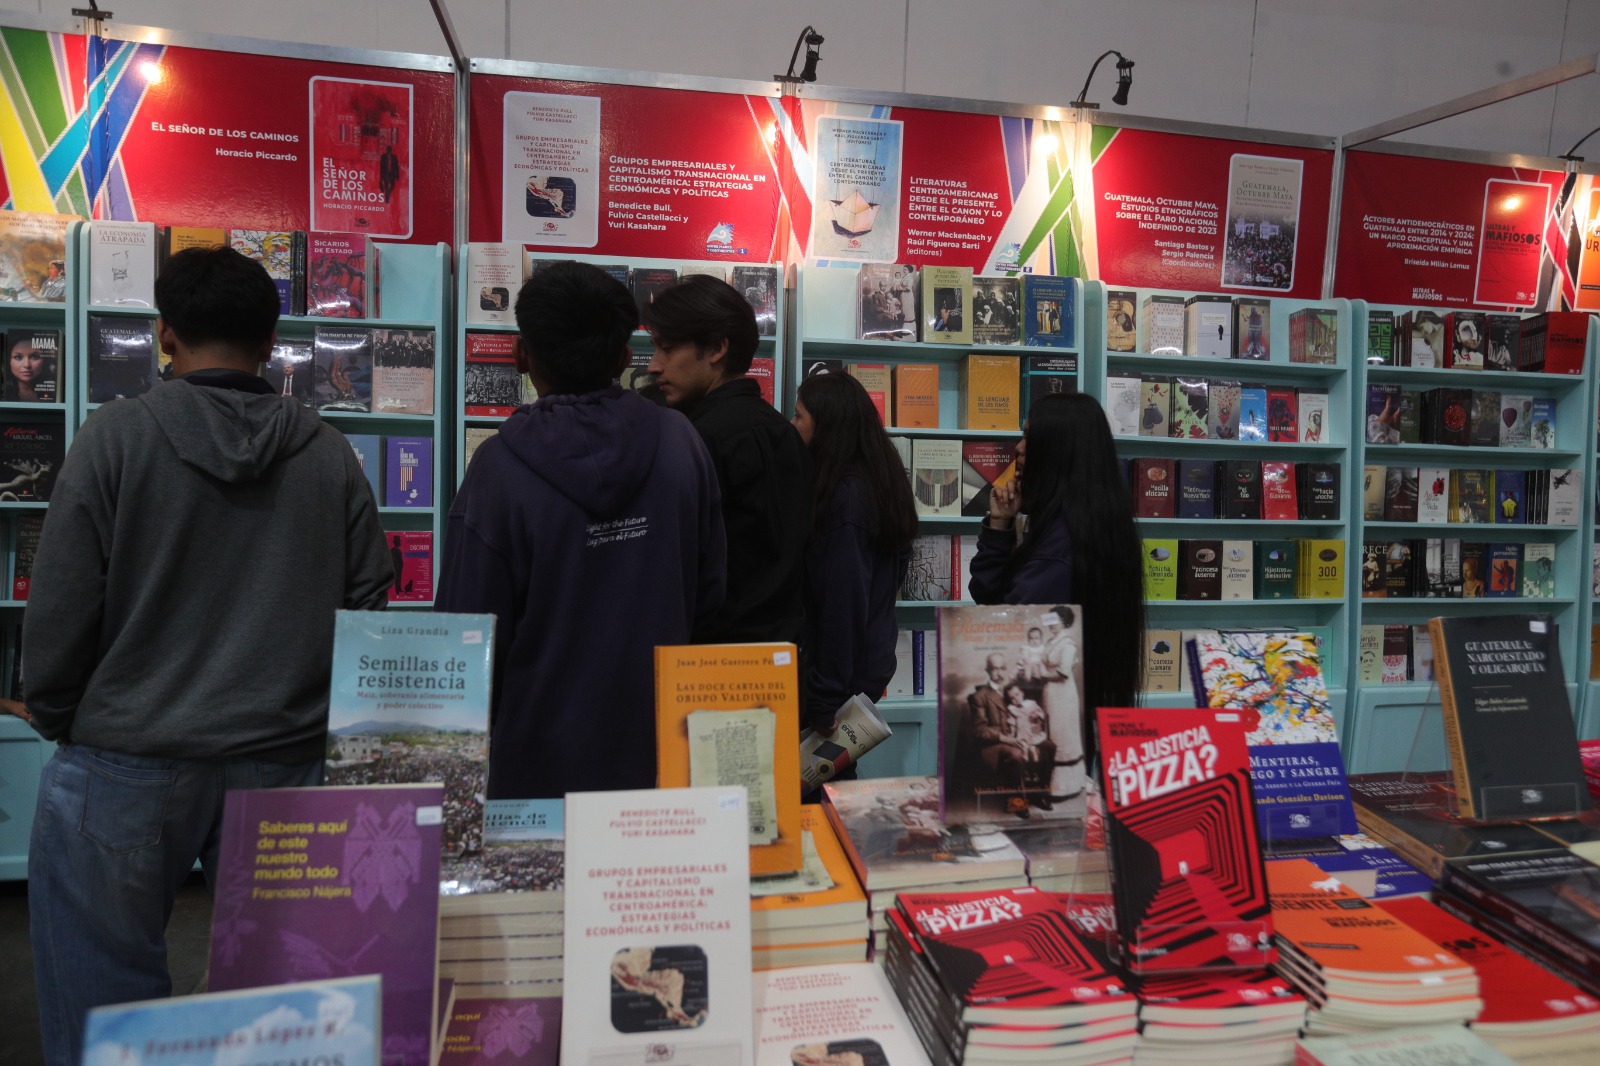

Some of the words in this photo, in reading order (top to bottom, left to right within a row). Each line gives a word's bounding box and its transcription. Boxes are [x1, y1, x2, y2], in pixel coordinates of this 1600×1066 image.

[152, 122, 165, 131] EL
[169, 124, 205, 135] SEÑOR
[209, 128, 223, 136] DE
[227, 130, 247, 138] LOS
[250, 132, 299, 142] CAMINOS
[216, 148, 253, 158] Horacio
[256, 151, 297, 161] Piccardo
[323, 158, 335, 168] EL
[610, 156, 648, 165] GRUPOS
[652, 160, 726, 170] EMPRESARIALES
[323, 167, 366, 180] SEÑOR
[609, 166, 670, 176] CAPITALISMO
[674, 170, 751, 181] TRANSNACIONAL
[324, 179, 338, 188] DE
[342, 181, 363, 190] LOS
[609, 176, 691, 186] CENTROAMÉRICA:
[694, 181, 753, 190] ESTRATEGIAS
[910, 176, 967, 188] LITERATURAS
[323, 190, 384, 202] CAMINOS
[609, 184, 670, 194] ECONÓMICAS
[682, 188, 729, 198] POLÍTICAS
[910, 187, 998, 199] CENTROAMERICANAS
[608, 202, 651, 210] Benedicte
[654, 204, 672, 212] Bull,
[910, 195, 937, 203] DESDE
[952, 199, 997, 208] PRESENTE.
[1157, 198, 1192, 208] OCTUBRE
[909, 203, 937, 212] ENTRE
[952, 207, 981, 215] CANON
[1121, 203, 1159, 212] ESTUDIOS
[1162, 207, 1218, 218] ETNOGRÁFICOS
[636, 213, 681, 222] Castellacci
[909, 213, 985, 224] CONTEMPORÁNEO
[1155, 214, 1176, 223] PARO
[1179, 216, 1217, 226] NACIONAL
[1363, 215, 1395, 224] ACTORES
[1397, 219, 1464, 231] ANTIDEMOCRÁTICOS
[628, 222, 666, 230] Kasahara
[1139, 221, 1183, 232] INDEFINIDO
[1364, 223, 1405, 233] GUATEMALA
[1455, 231, 1474, 239] 2024:
[908, 229, 936, 237] Werner
[938, 231, 985, 240] Mackenbach
[1408, 236, 1451, 245] CONCEPTUAL
[1486, 231, 1540, 245] MAFIOSOS
[908, 238, 924, 246] Raúl
[927, 240, 960, 249] Figueroa
[1154, 240, 1184, 249] Santiago
[1387, 242, 1438, 252] APROXIMACIÓN
[1441, 246, 1472, 255] EMPÍRICA
[907, 248, 942, 257] (editores)
[1162, 250, 1183, 258] Sergio
[1162, 259, 1214, 269] (Coordinadores)
[1412, 293, 1442, 301] MAFIOSOS
[1319, 567, 1336, 577] 300
[381, 626, 403, 635] Liza
[407, 627, 449, 636] Grandia
[677, 659, 696, 667] Juan
[700, 659, 717, 667] José
[721, 658, 758, 666] Guerrero
[1467, 651, 1545, 663] NARCOESTADO
[359, 655, 438, 672] Semillas
[445, 659, 466, 672] de
[1469, 665, 1477, 674] Y
[1479, 662, 1546, 674] OLIGARQUÍA
[358, 673, 466, 690] resistencia
[677, 683, 695, 691] LAS
[698, 683, 725, 691] DOCE
[729, 682, 765, 690] CARTAS
[768, 682, 785, 690] DEL
[677, 694, 717, 703] OBISPO
[722, 692, 786, 701] VALDIVIESO
[383, 702, 406, 710] poder
[1108, 746, 1139, 777] ¿LA
[1140, 725, 1211, 762] JUSTICIA
[1118, 744, 1218, 806] PIZZA?
[1250, 770, 1275, 779] EGO
[1279, 770, 1286, 778] Y
[1291, 767, 1338, 777] SANGRE
[1277, 795, 1312, 803] González
[620, 809, 673, 818] BENEDICTE
[676, 808, 695, 816] BULL
[259, 821, 315, 835] Saberes
[318, 820, 347, 835] aquí
[610, 819, 642, 829] FULVIO
[645, 818, 706, 827] CASTELLACCI
[621, 829, 642, 837] YURI
[645, 828, 695, 837] KASAHARA
[257, 836, 275, 849] de
[279, 836, 308, 848] este
[256, 851, 308, 864] nuestro
[255, 866, 303, 879] mundo
[306, 866, 338, 879] todo
[588, 867, 634, 877] GRUPOS
[637, 864, 728, 876] EMPRESARIALES
[626, 877, 700, 887] CAPITALISMO
[253, 886, 310, 899] Francisco
[314, 884, 351, 897] Nájera
[603, 889, 693, 900] TRANSNACIONAL
[697, 888, 714, 896] EN
[945, 895, 1012, 915] JUSTICIA
[622, 912, 696, 922] ESTRATEGIAS
[928, 902, 1023, 935] PIZZA?
[586, 922, 660, 937] ECONÓMICAS
[664, 923, 670, 932] Y
[674, 920, 731, 932] POLÍTICAS
